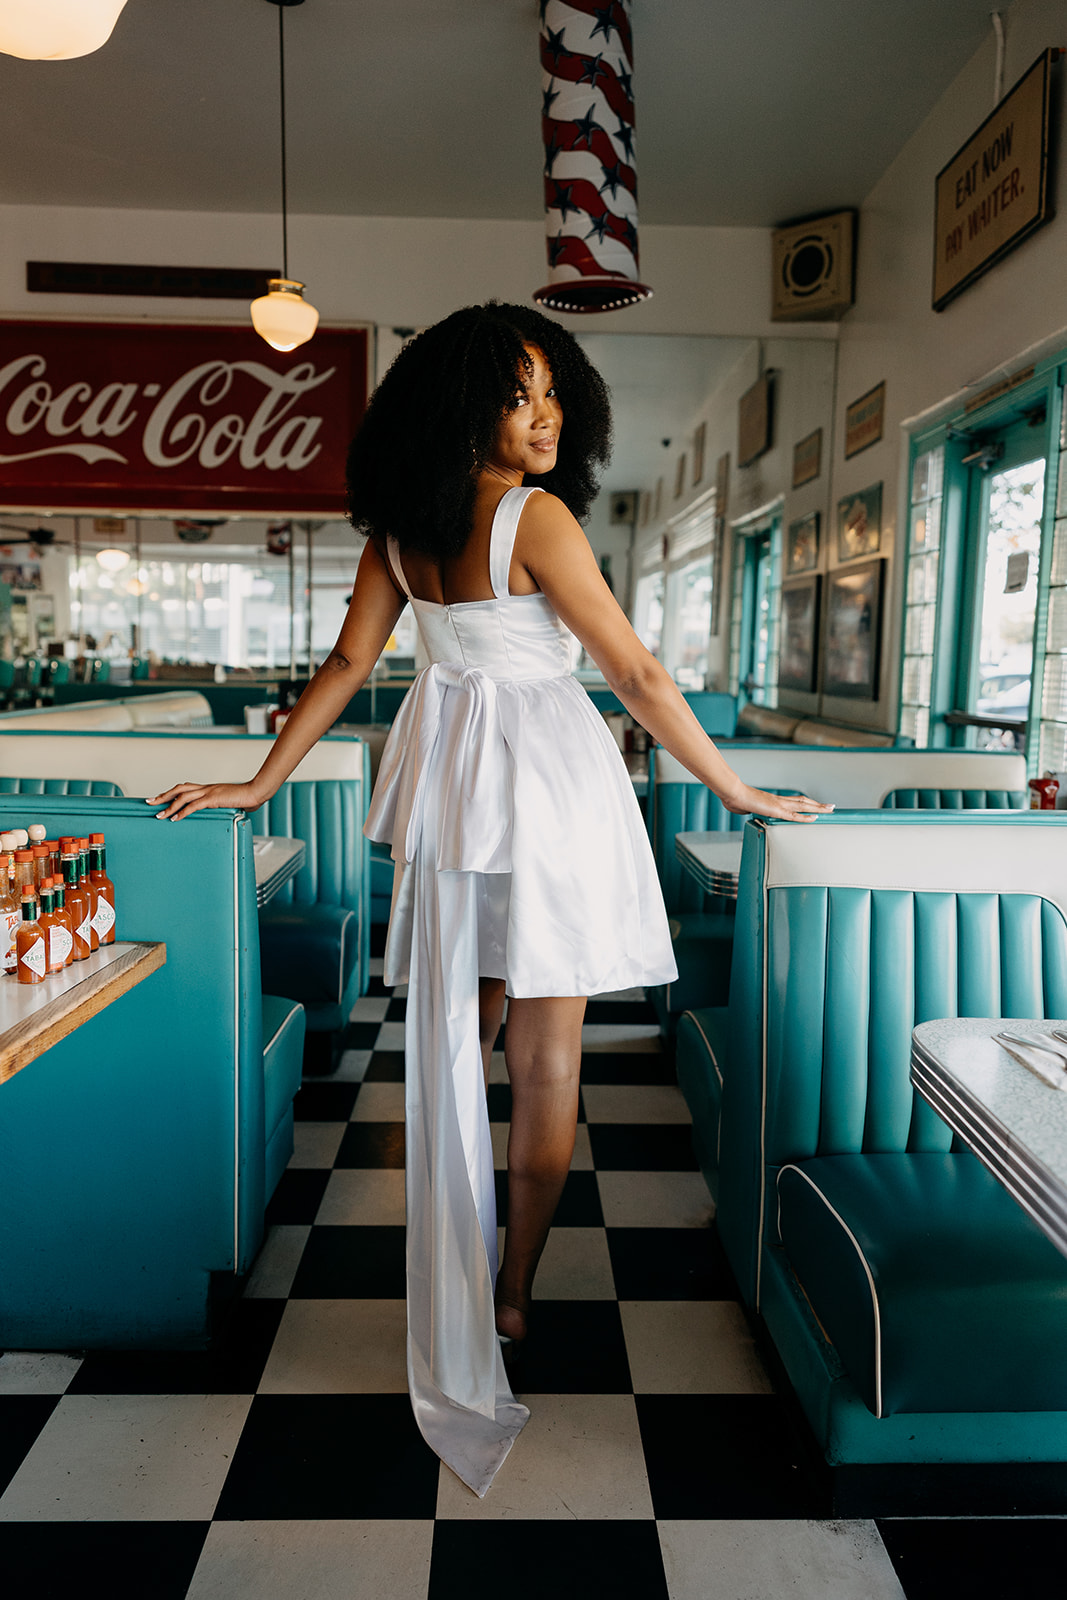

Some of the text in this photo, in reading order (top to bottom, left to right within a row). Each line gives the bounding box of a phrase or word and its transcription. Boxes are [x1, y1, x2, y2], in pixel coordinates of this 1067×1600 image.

[955, 122, 1014, 210] EAT NOW
[945, 167, 1025, 263] PAY WAITER.
